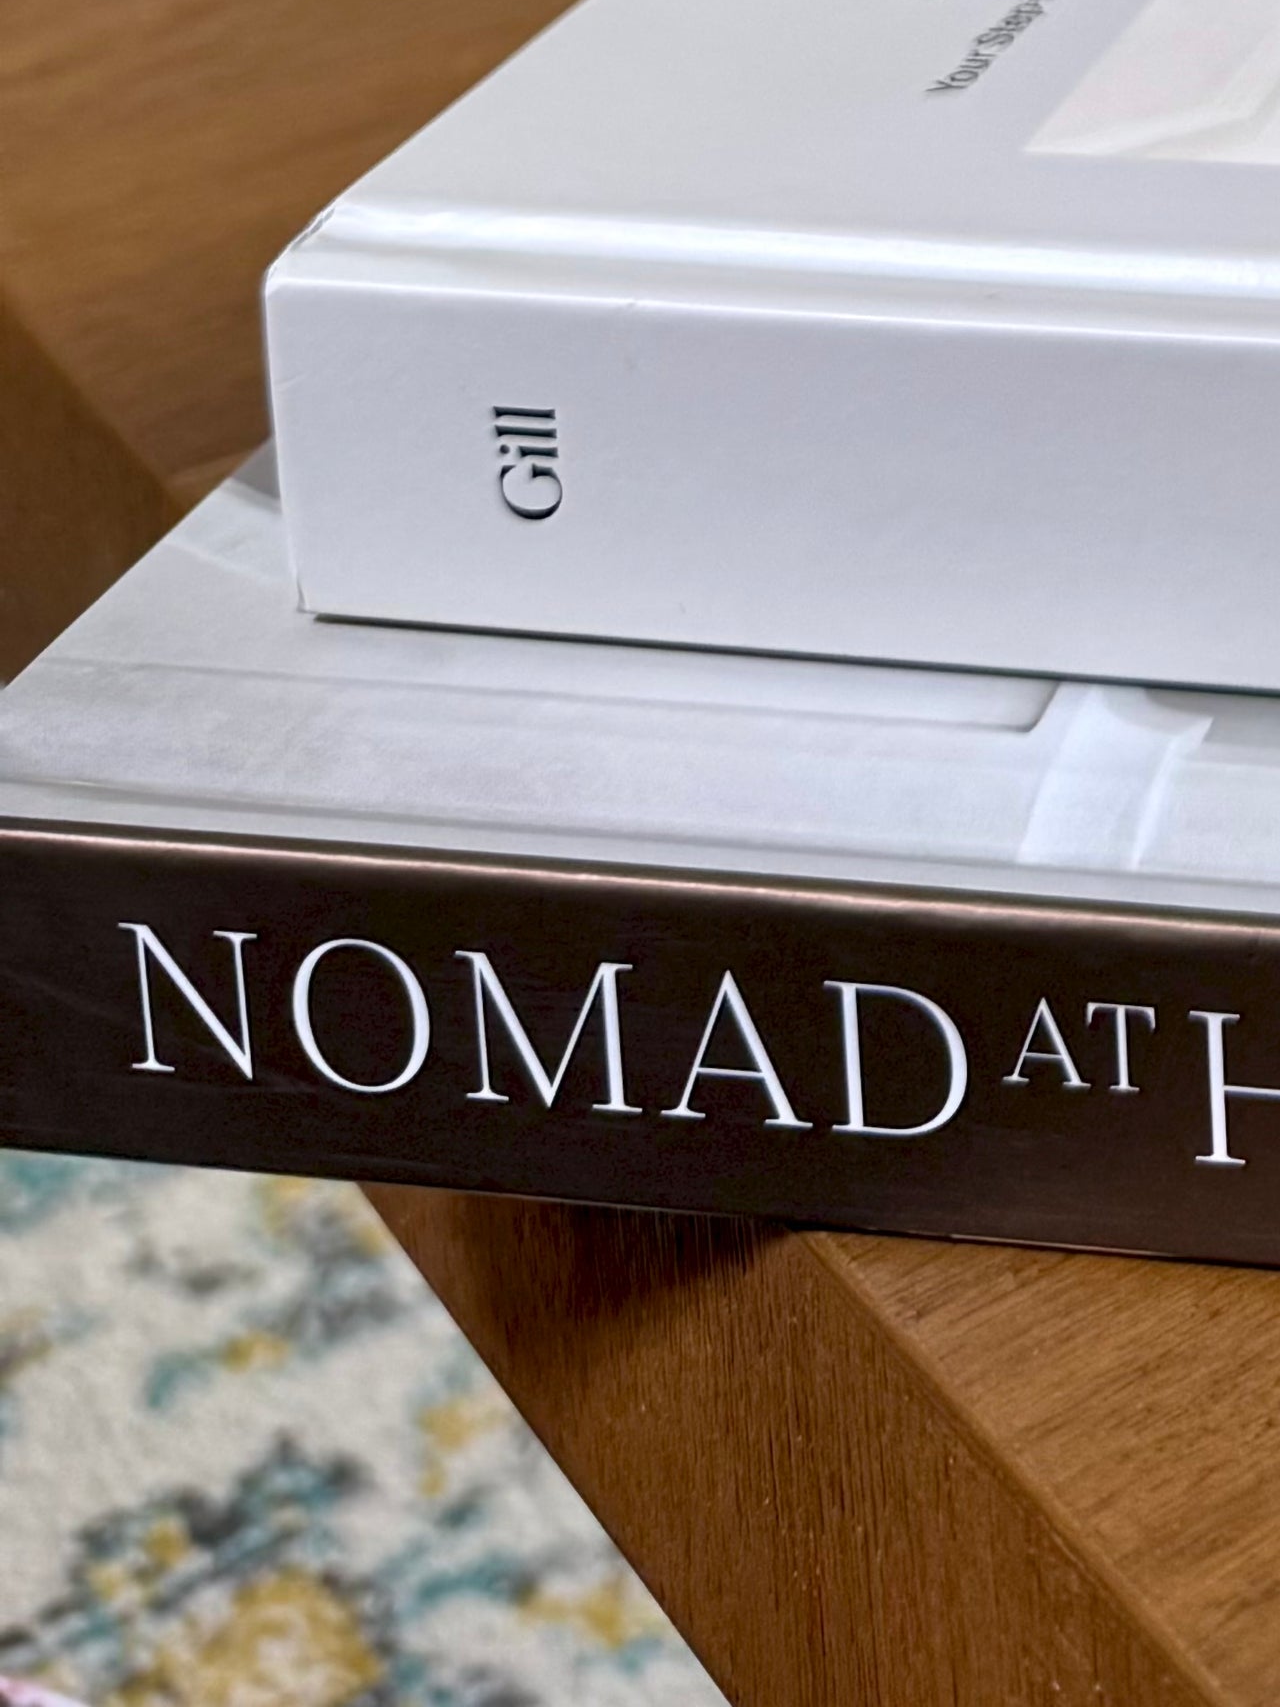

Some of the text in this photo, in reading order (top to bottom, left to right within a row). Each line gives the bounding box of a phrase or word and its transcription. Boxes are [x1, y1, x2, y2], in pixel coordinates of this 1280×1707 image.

[924, 49, 996, 94] Your
[492, 406, 563, 521] Gill
[118, 920, 971, 1137] NOMAD
[1003, 997, 1156, 1093] AT
